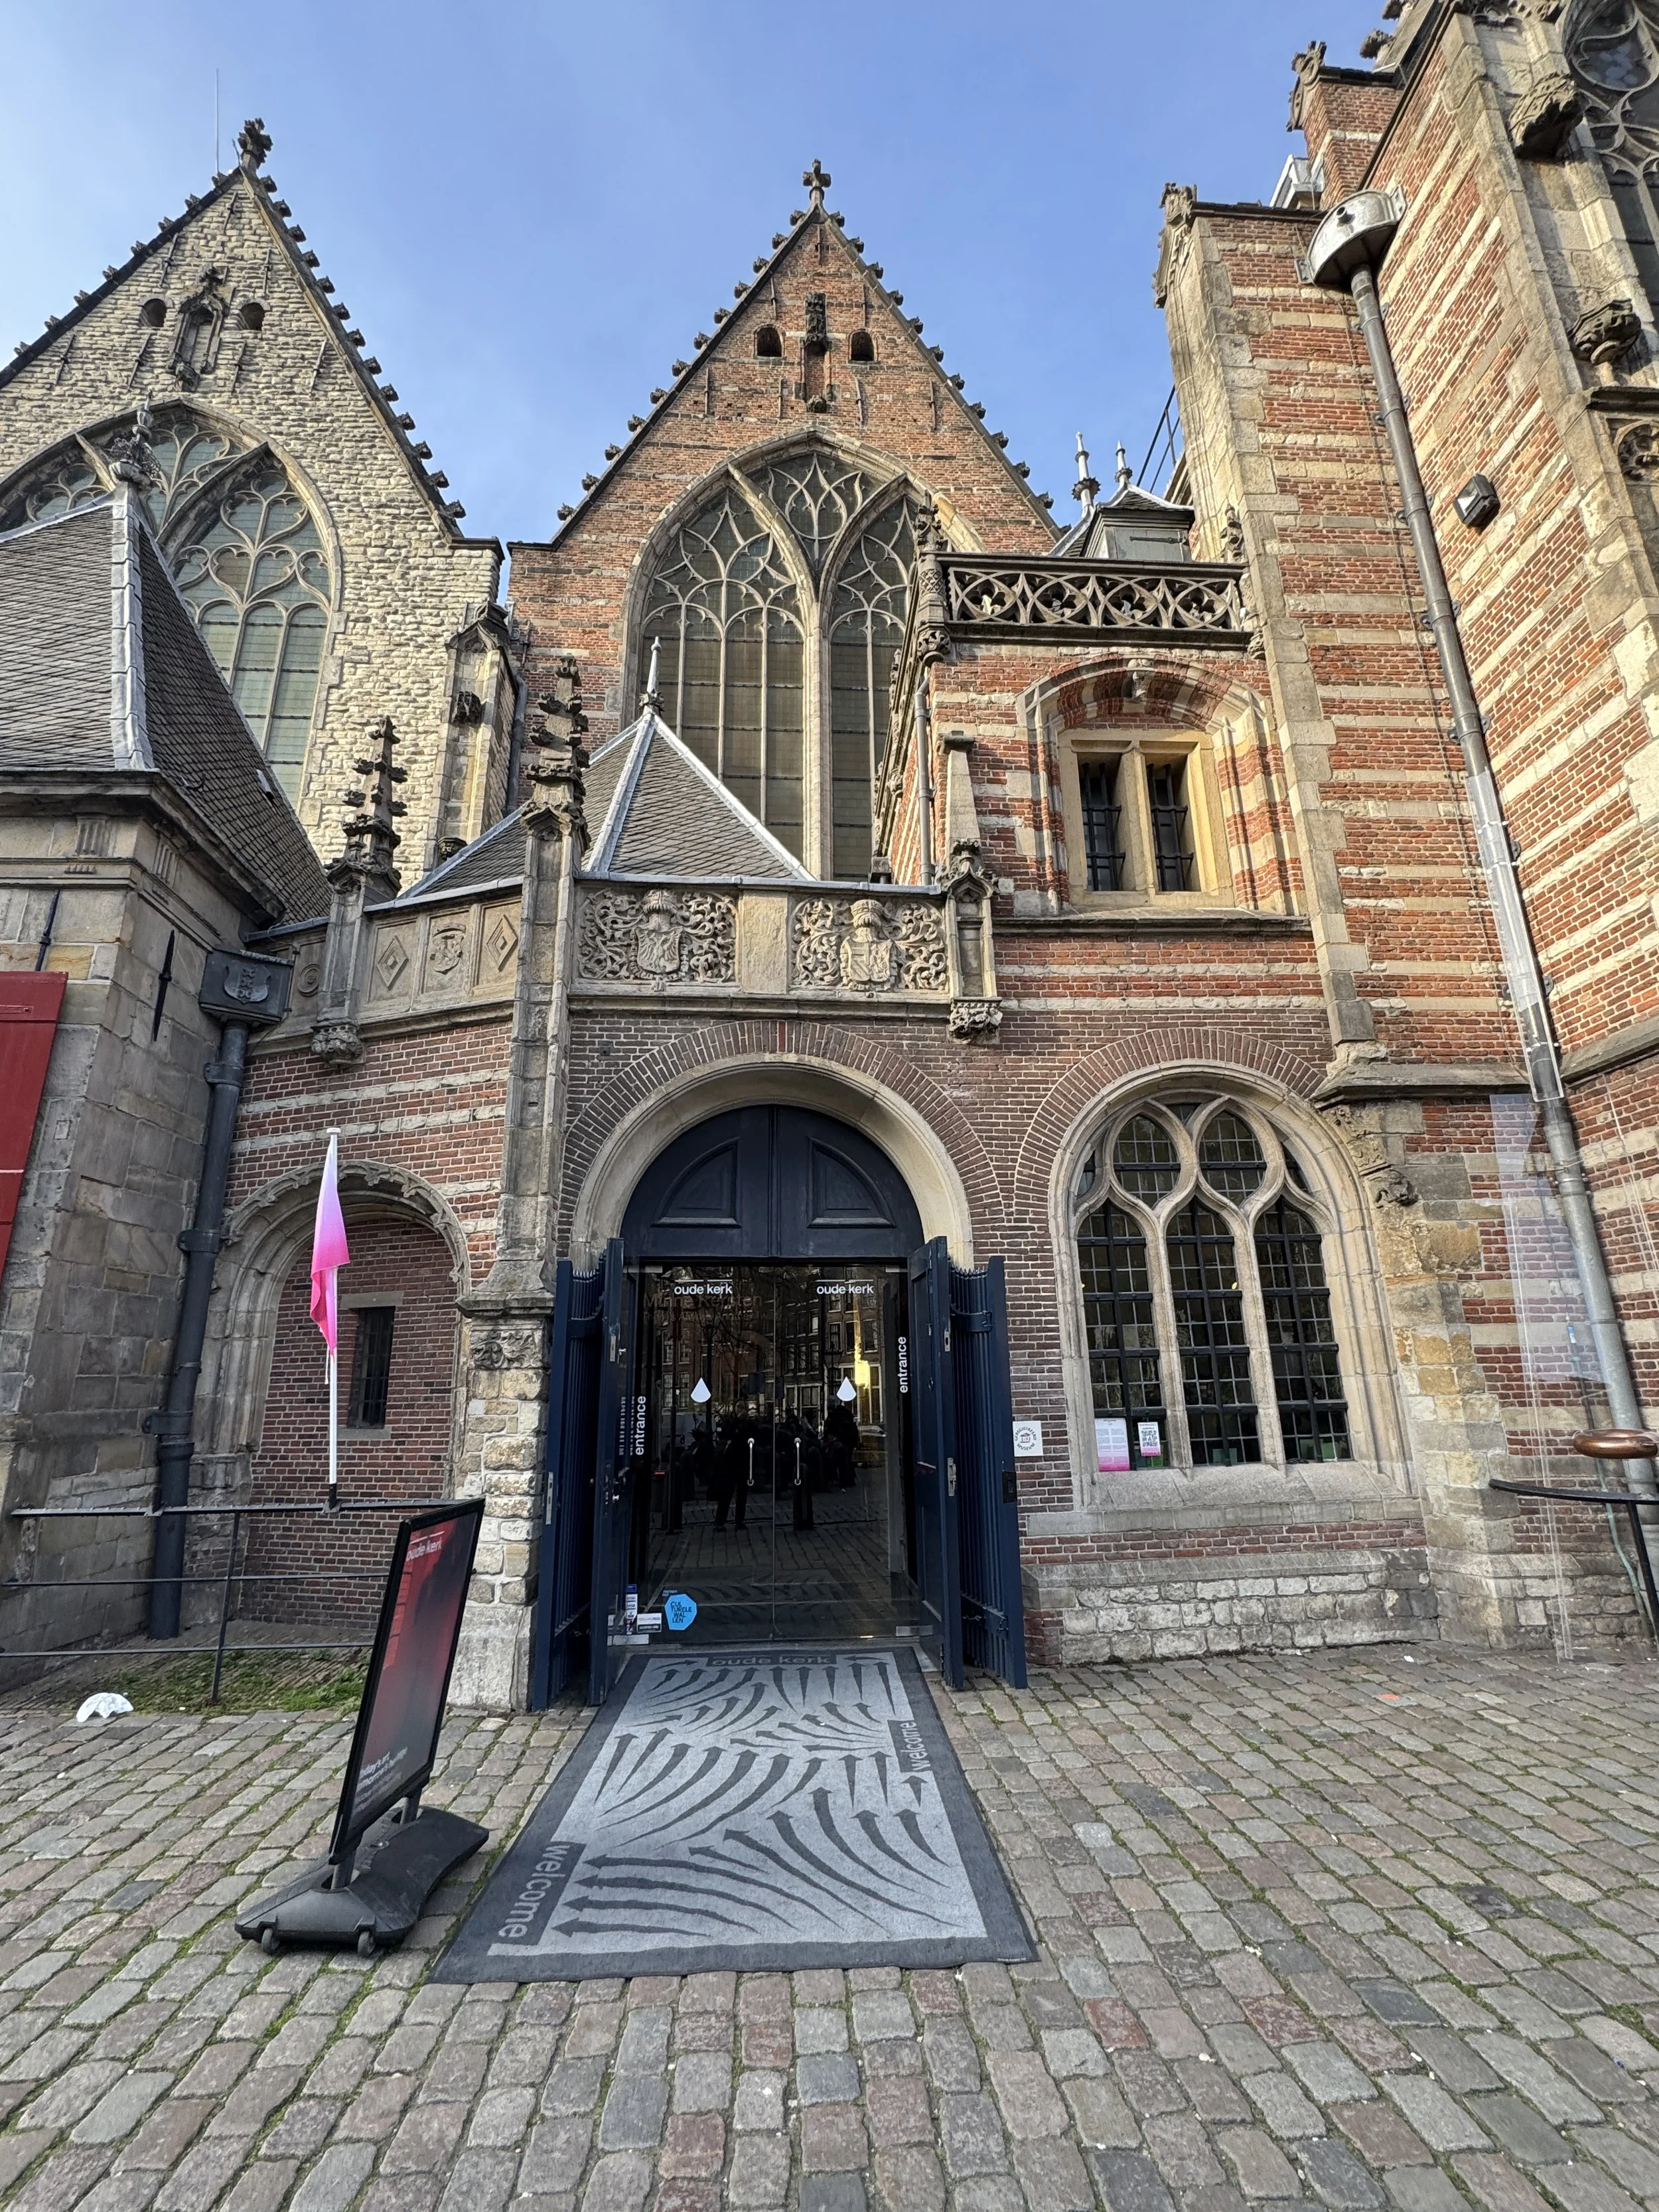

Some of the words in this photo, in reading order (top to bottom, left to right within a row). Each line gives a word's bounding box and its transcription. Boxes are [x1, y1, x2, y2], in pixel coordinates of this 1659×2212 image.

[674, 1283, 703, 1295] oude
[707, 1283, 733, 1295] kerk
[816, 1284, 845, 1295] oude
[848, 1284, 874, 1295] kerk
[897, 1336, 908, 1394] entrance
[634, 1395, 646, 1456] entrance
[405, 1543, 425, 1562] oude
[712, 1657, 771, 1666] oude
[778, 1656, 830, 1664] kerk
[900, 1721, 932, 1771] welcome
[498, 1844, 571, 1938] welcome
